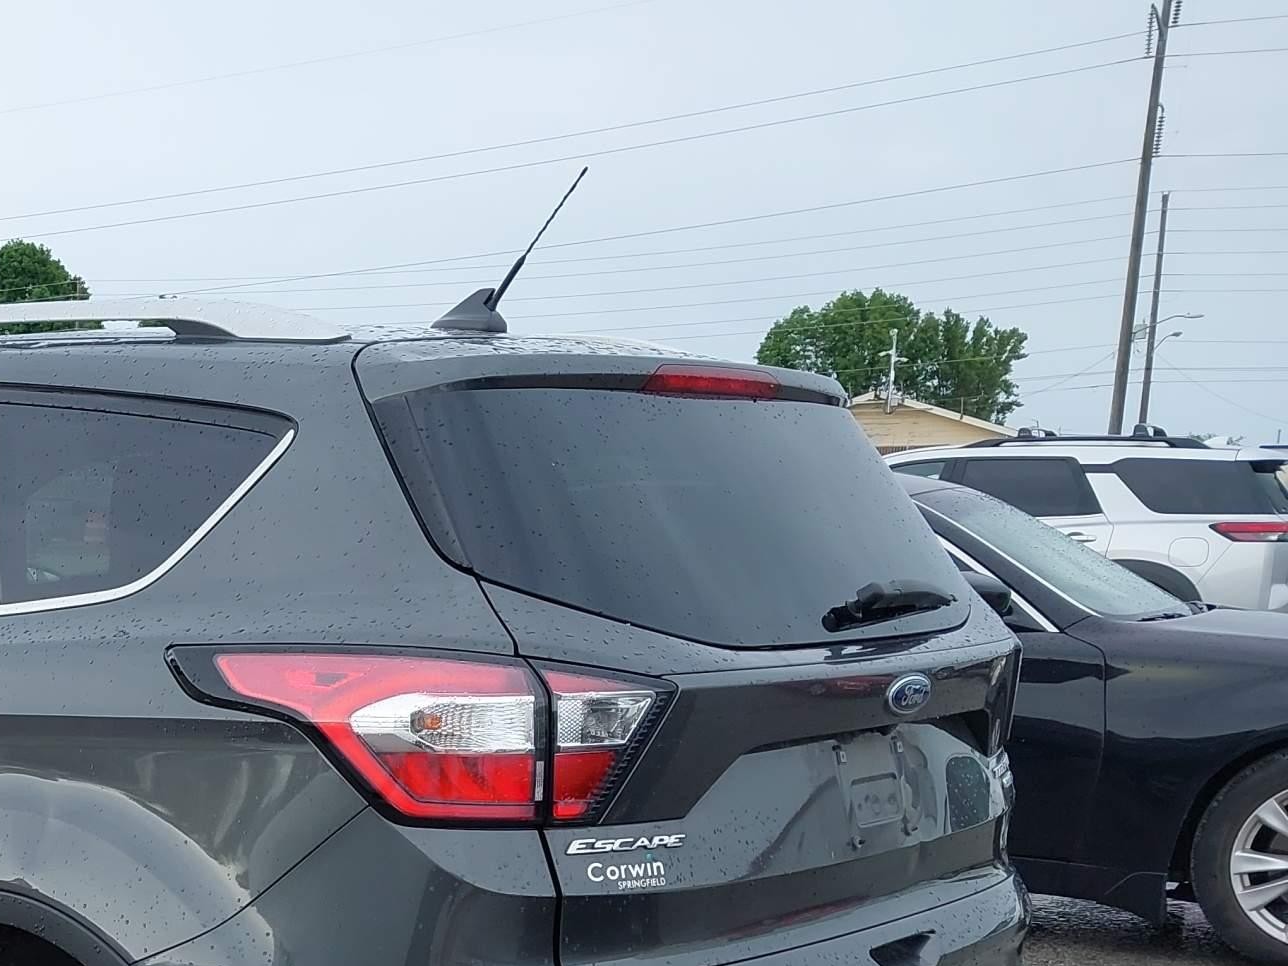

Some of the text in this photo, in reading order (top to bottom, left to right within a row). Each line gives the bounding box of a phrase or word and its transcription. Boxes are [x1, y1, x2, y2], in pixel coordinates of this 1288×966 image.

[901, 684, 930, 706] Ford
[566, 834, 686, 855] ESCAPE
[587, 854, 665, 882] Corwin
[617, 877, 666, 890] SPRINGFIELD
